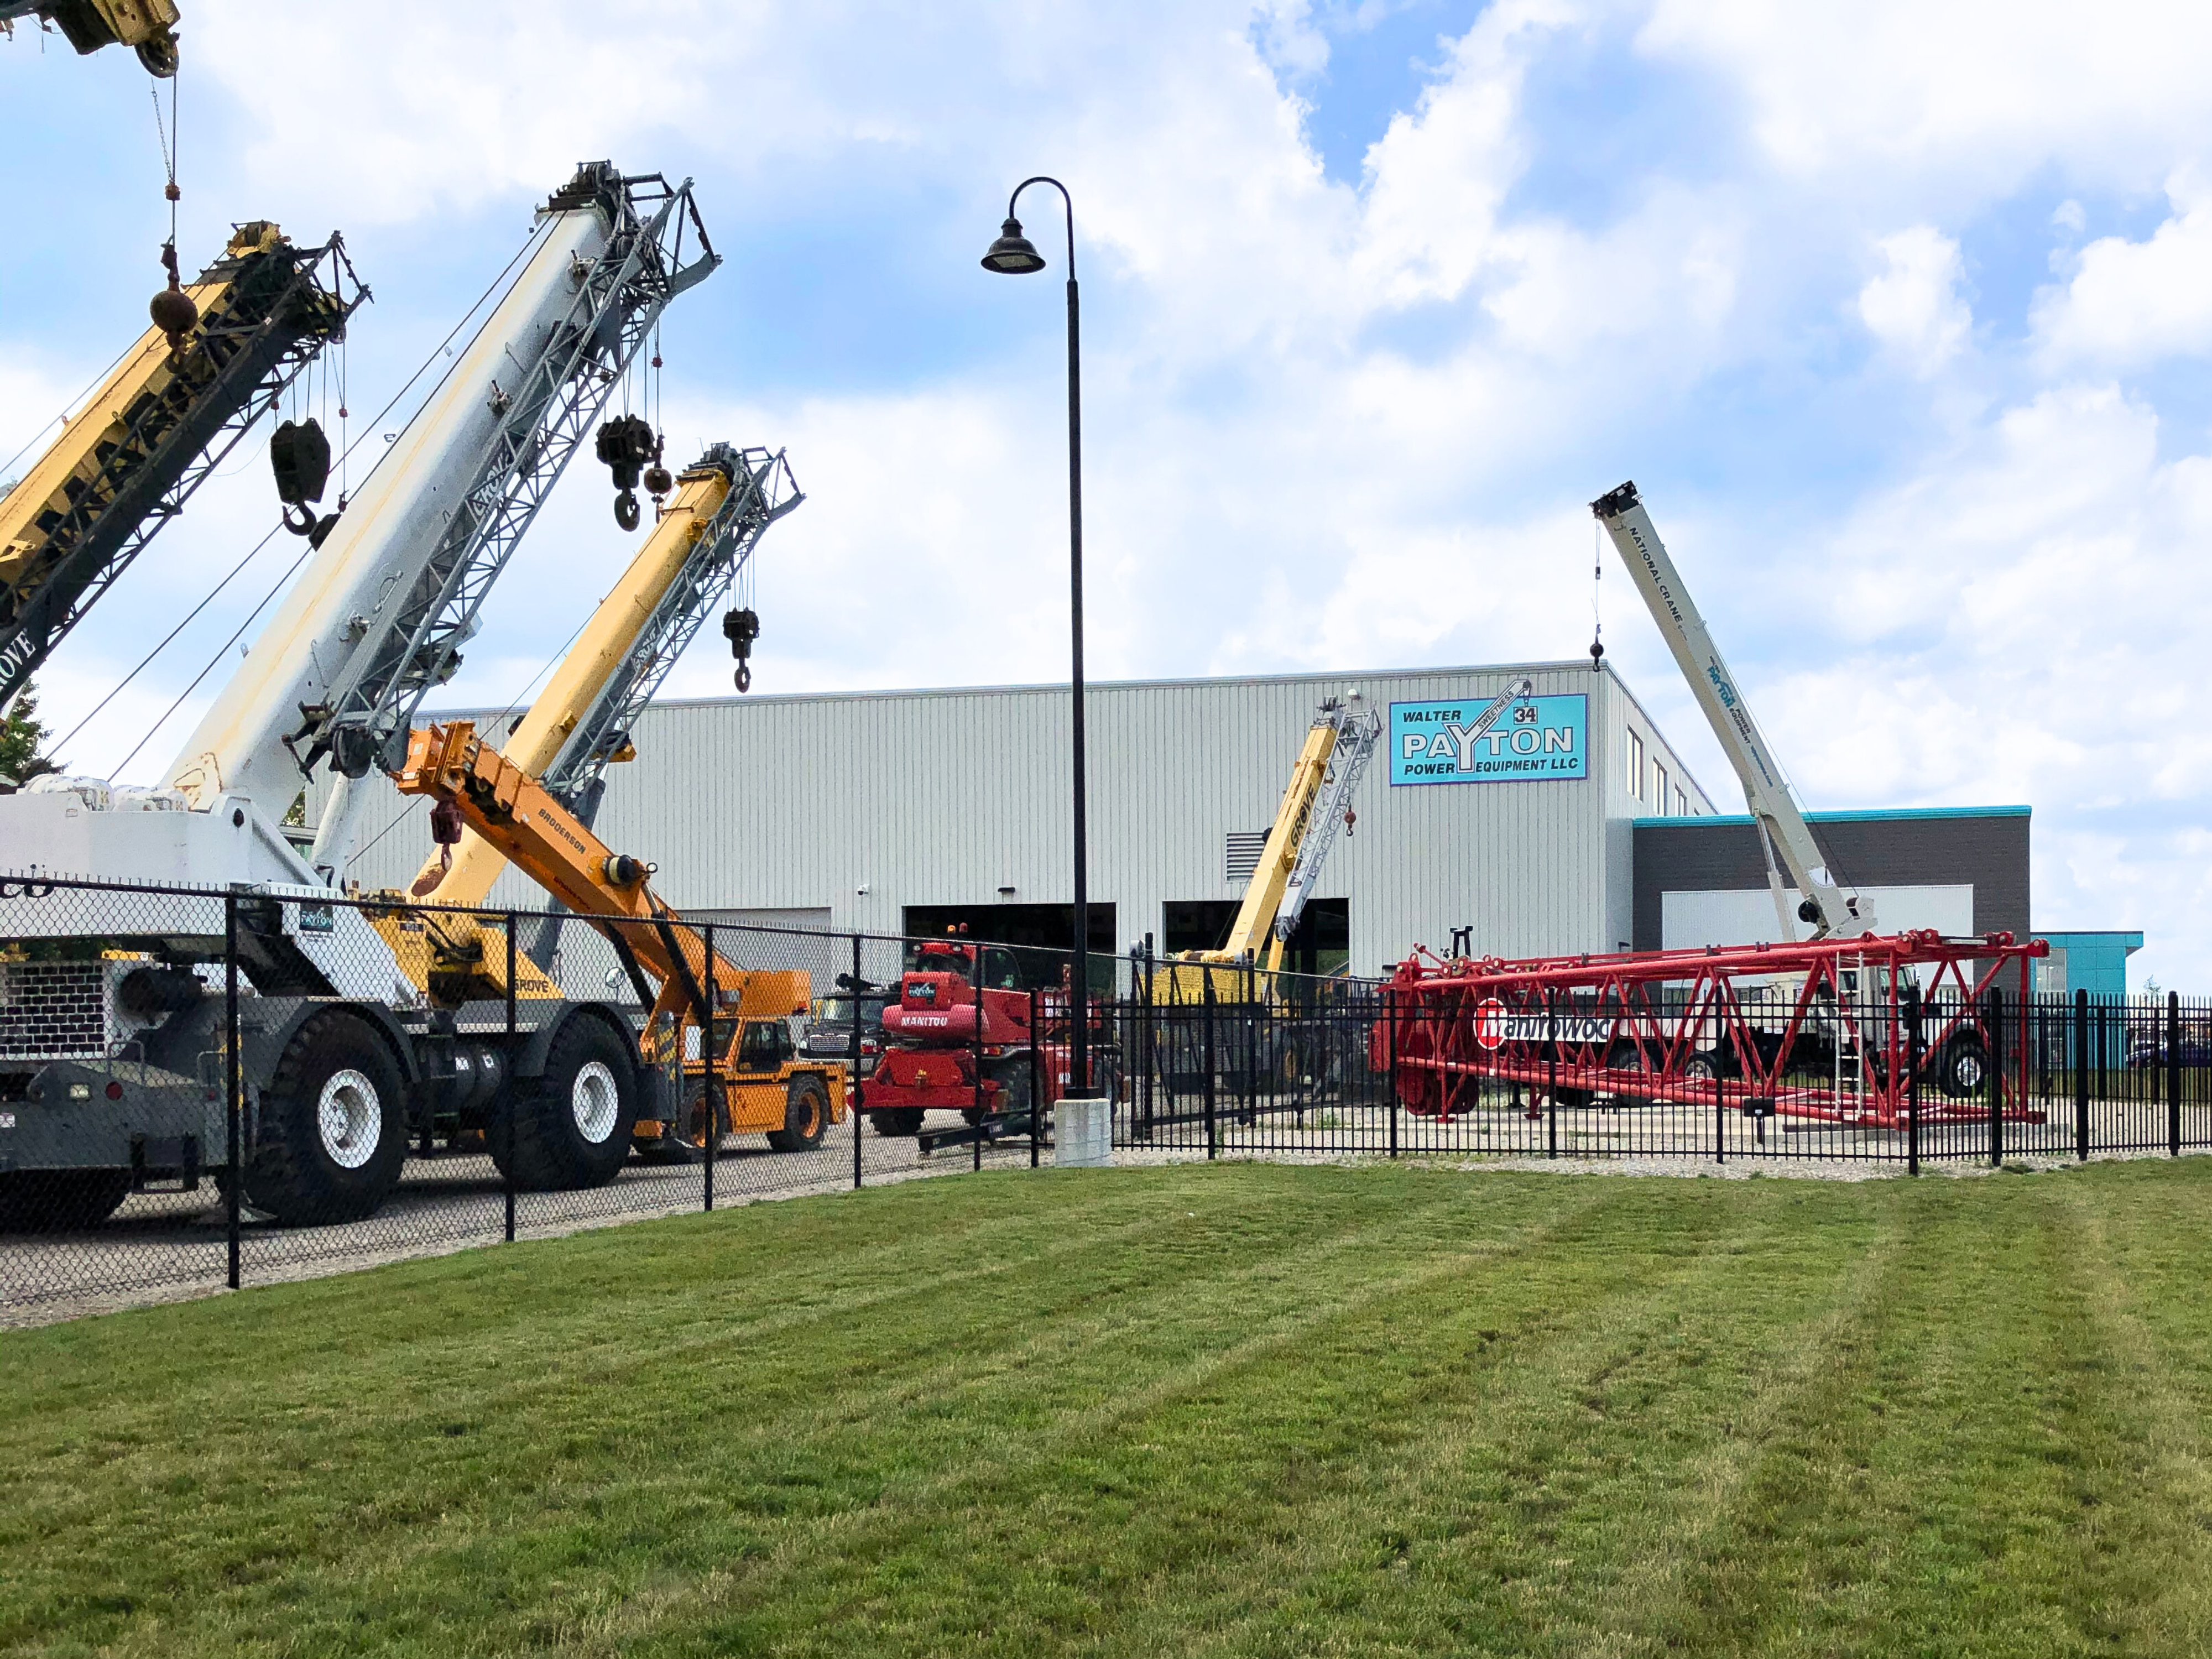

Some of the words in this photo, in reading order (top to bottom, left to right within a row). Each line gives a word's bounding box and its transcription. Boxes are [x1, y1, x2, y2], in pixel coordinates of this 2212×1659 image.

[1629, 526, 1662, 585] NATIONAL
[1659, 585, 1683, 623] CRANE
[0, 630, 36, 692] OVE
[1707, 665, 1736, 708] PAYTON
[1403, 710, 1462, 723] WALTER
[1478, 690, 1515, 729] SWEETNESS
[1515, 707, 1536, 723] 34
[1729, 707, 1751, 745] EQUIPMENT
[1735, 708, 1751, 734] POWER
[1402, 722, 1573, 773] PAYTON
[1404, 763, 1455, 775] POWER
[1475, 759, 1547, 773] EQUIPMENT
[1551, 758, 1579, 770] LLC
[538, 808, 586, 854] BRODERSON
[1291, 782, 1316, 847] GROVE
[901, 1016, 948, 1026] MANITOU
